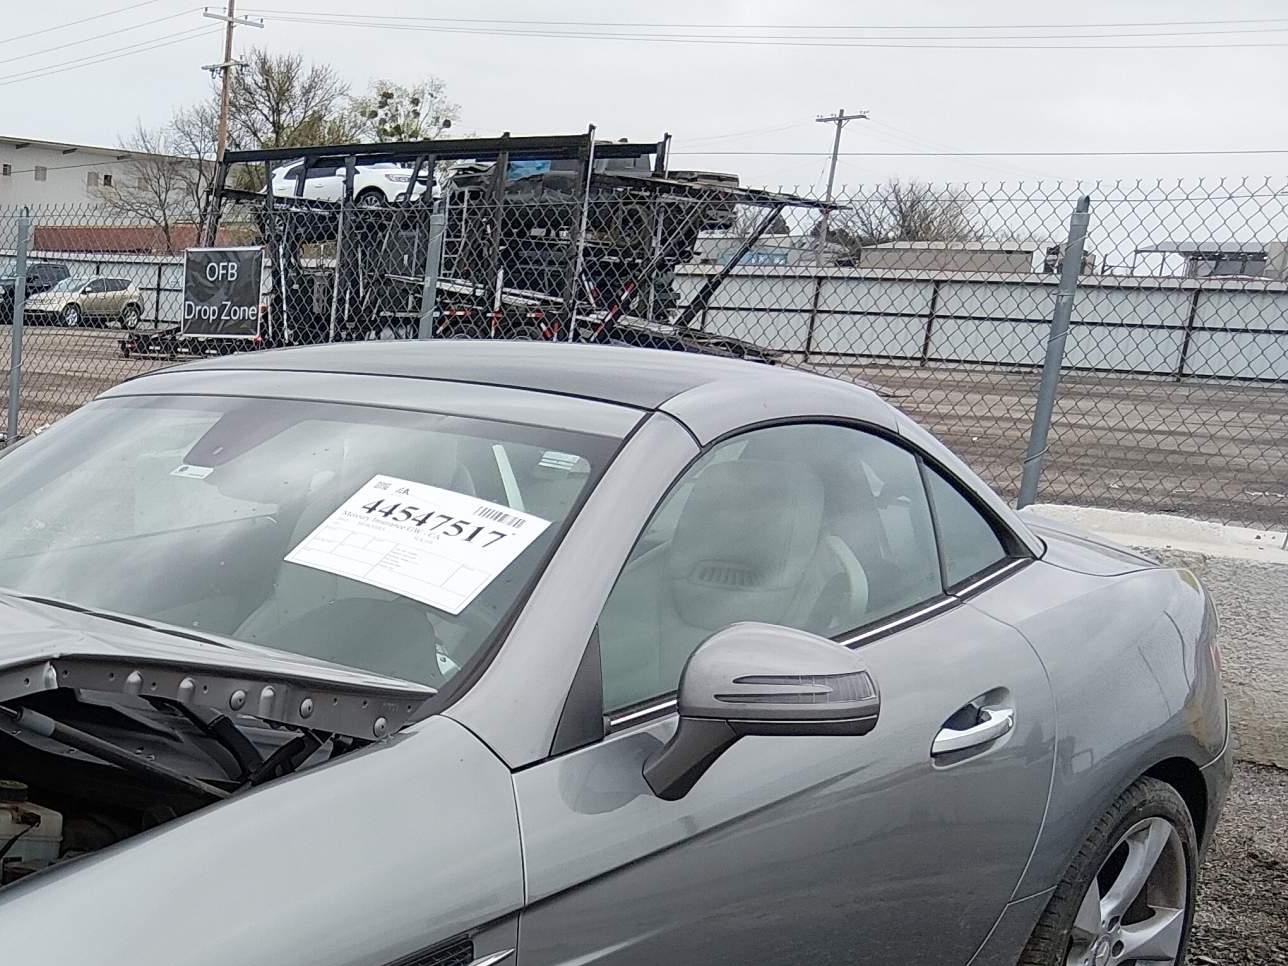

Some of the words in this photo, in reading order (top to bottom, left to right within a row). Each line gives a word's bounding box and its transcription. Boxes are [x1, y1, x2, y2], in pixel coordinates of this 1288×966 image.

[206, 262, 238, 281] OFB
[184, 301, 218, 323] Drop
[220, 301, 257, 320] Zone
[361, 499, 507, 548] 44547517
